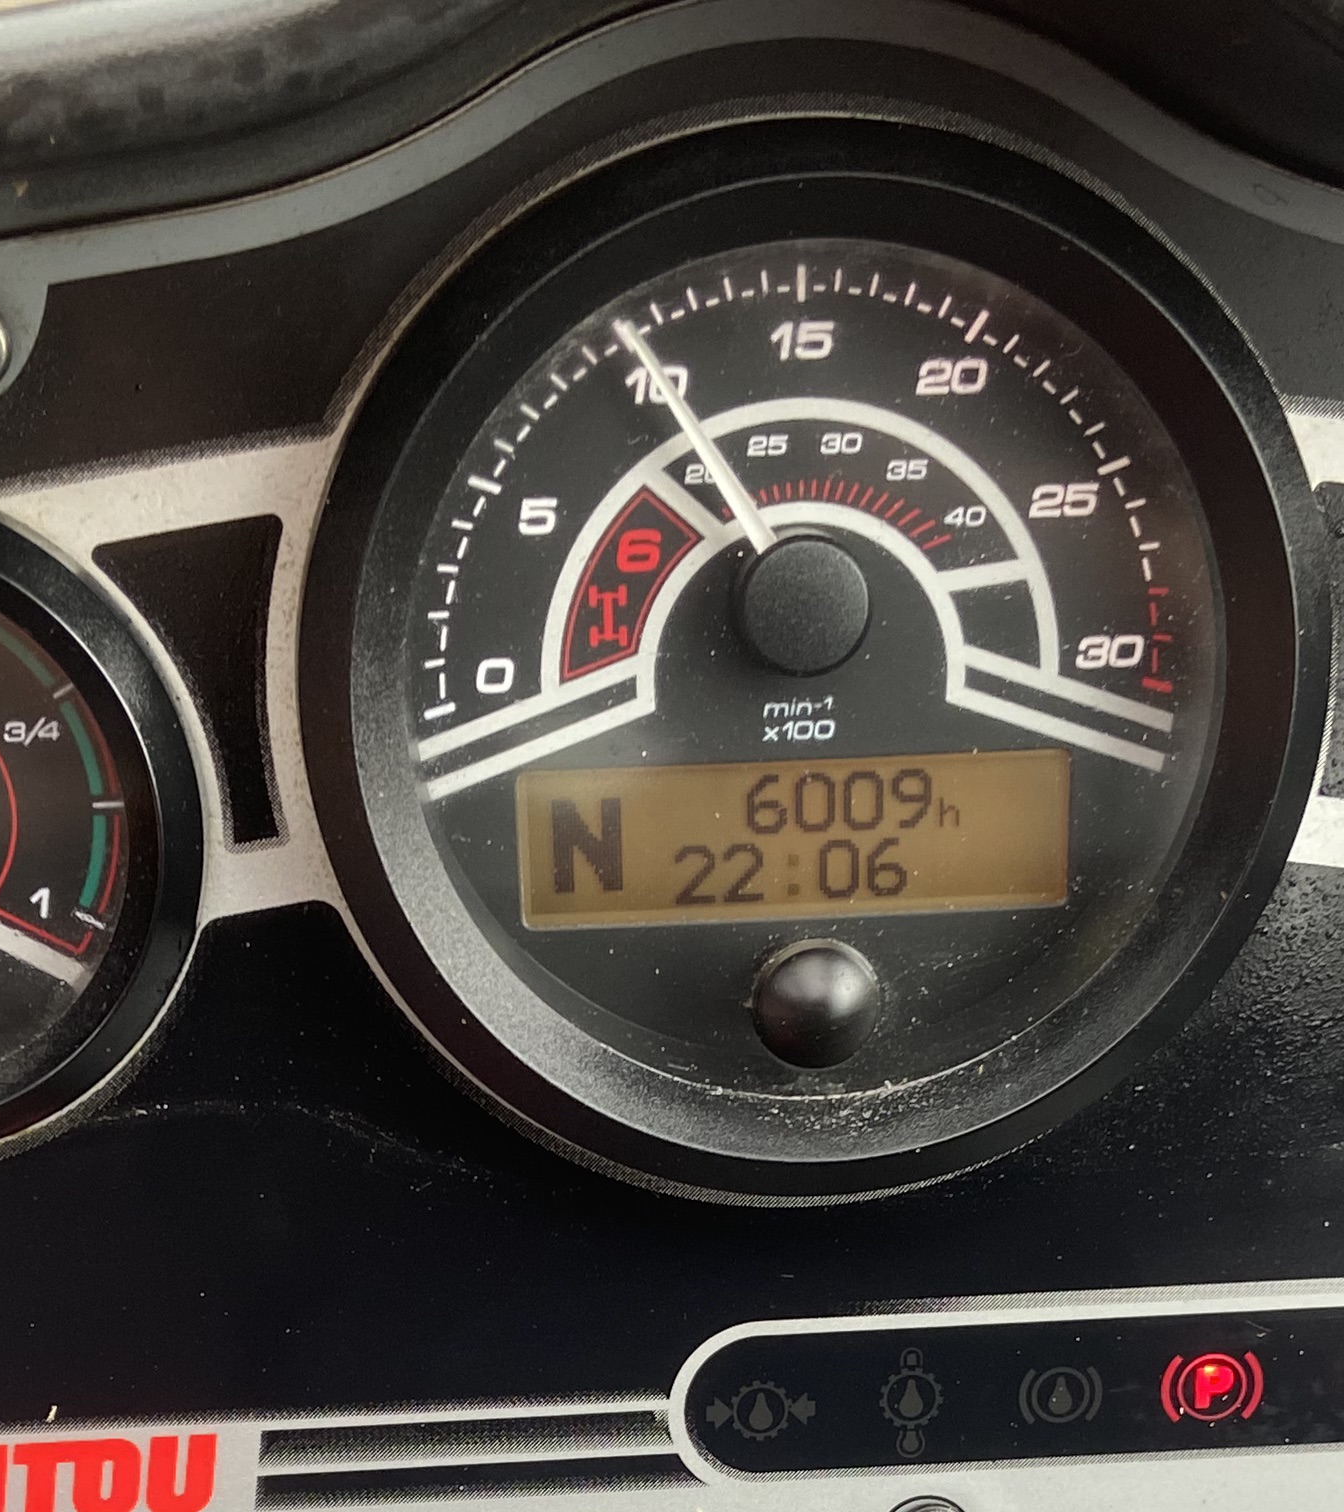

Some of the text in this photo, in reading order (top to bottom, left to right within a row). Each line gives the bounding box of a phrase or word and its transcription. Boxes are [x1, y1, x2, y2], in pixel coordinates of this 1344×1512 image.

[769, 319, 835, 361] 15
[624, 365, 689, 405] 10
[915, 357, 989, 397] 20
[746, 436, 788, 457] 25
[819, 433, 864, 455] 30
[886, 459, 929, 482] 35
[519, 498, 557, 537] 5
[943, 506, 987, 528] 40
[1028, 482, 1099, 519] 25
[615, 528, 663, 573] 6
[1075, 634, 1145, 671] 30
[475, 656, 516, 696] 0
[3, 719, 62, 744] 3/4
[761, 720, 837, 742] x100
[745, 768, 935, 836] 6009
[552, 798, 624, 893] N
[673, 839, 909, 905] 22:06
[29, 888, 52, 919] 1
